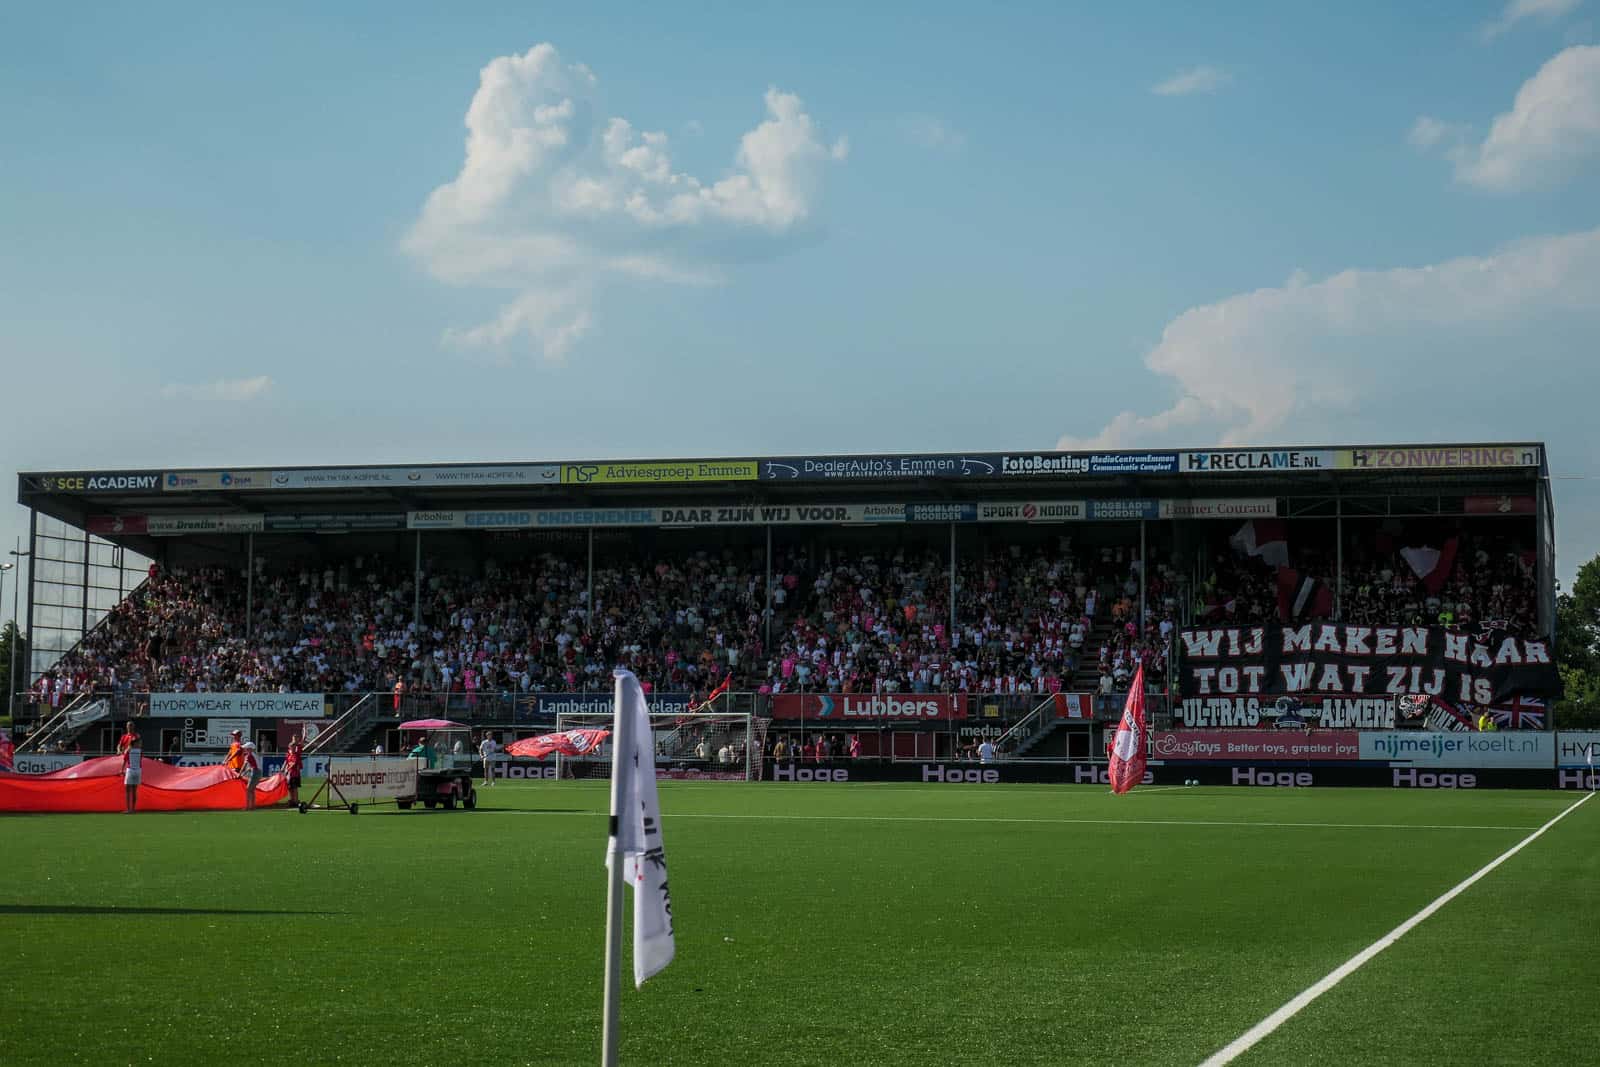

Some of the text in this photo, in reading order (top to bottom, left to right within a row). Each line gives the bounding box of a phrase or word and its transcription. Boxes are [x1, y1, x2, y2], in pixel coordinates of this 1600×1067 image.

[804, 459, 954, 472] DealerAuto's Emmen
[1002, 455, 1090, 473] FotoBenting
[606, 465, 751, 481] Adviesgroep Emmen
[57, 476, 158, 490] SCE ACADEMY
[913, 505, 961, 513] DAGBLAD
[983, 505, 1019, 517] SPORT
[1040, 505, 1079, 517] NOORD
[1093, 501, 1140, 510] DAGBLAD
[1216, 503, 1270, 514] Courant
[413, 512, 453, 521] ArboNed
[464, 511, 530, 526] GEZOND
[661, 509, 712, 523] DAAR
[717, 508, 753, 523] ZIJN
[760, 507, 791, 521] WIJ
[797, 505, 851, 521] VOOR.
[913, 512, 962, 521] NOORDEN
[1093, 510, 1143, 519] NOORDEN
[1181, 624, 1549, 668] WIJ MAKEN HAAR
[1193, 662, 1492, 705] TOT WAT ZIJ IS
[152, 699, 320, 711] HYDROWEAR HYDROWEAR
[538, 698, 614, 713] Lamberink
[842, 695, 938, 716] Lubbers
[1183, 697, 1260, 727] ULTRAS
[1227, 743, 1259, 753] Better
[1263, 743, 1287, 754] toys,
[1291, 743, 1331, 755] greater
[1335, 743, 1357, 756] joys
[1374, 736, 1538, 759] nijmeijer koelt.nl
[331, 769, 386, 786] oldenburger
[773, 763, 849, 782] Hoge
[921, 765, 1000, 783] Hoge
[1075, 766, 1154, 784] Hoe
[1231, 767, 1312, 788] Hoge
[1393, 768, 1477, 790] Hoge
